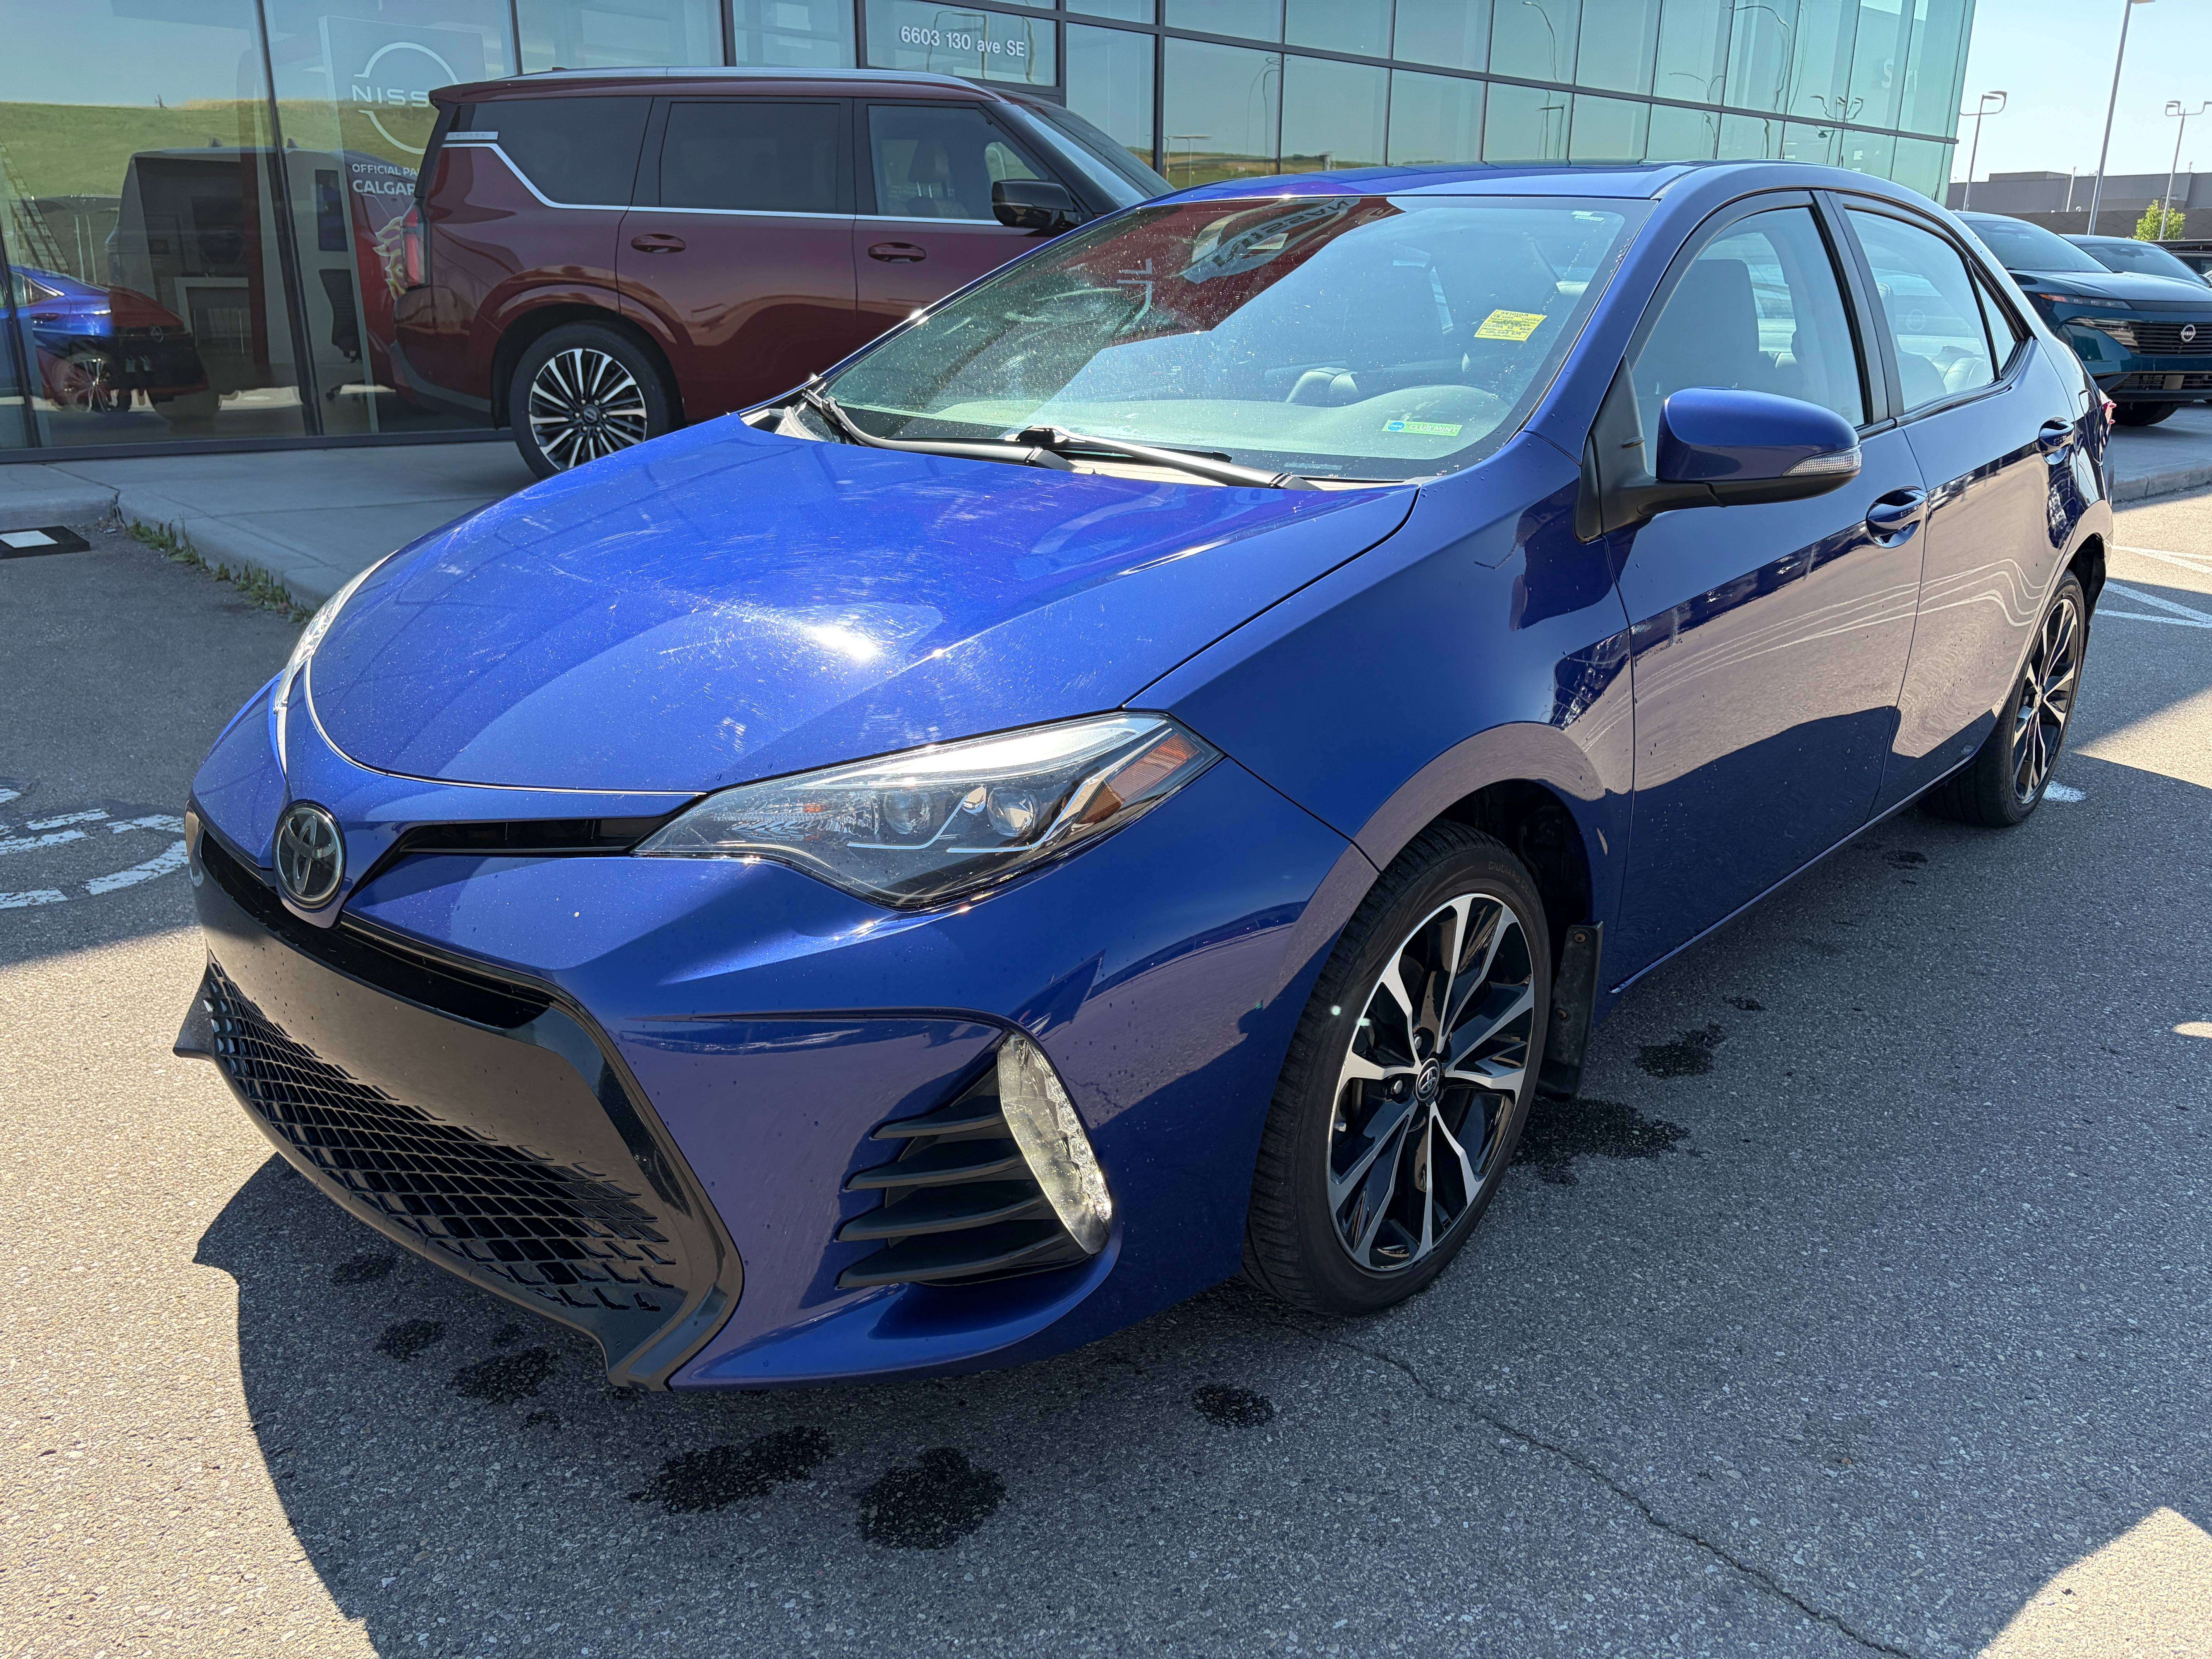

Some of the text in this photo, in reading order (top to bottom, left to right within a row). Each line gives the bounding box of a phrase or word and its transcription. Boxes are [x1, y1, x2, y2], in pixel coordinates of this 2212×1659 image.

[901, 26, 1025, 57] 6603 130 ave SE
[352, 84, 429, 107] NISS
[352, 163, 420, 177] OFFICIAL PA
[353, 180, 416, 196] CALGAR
[1488, 862, 1521, 883] GIUGIARO
